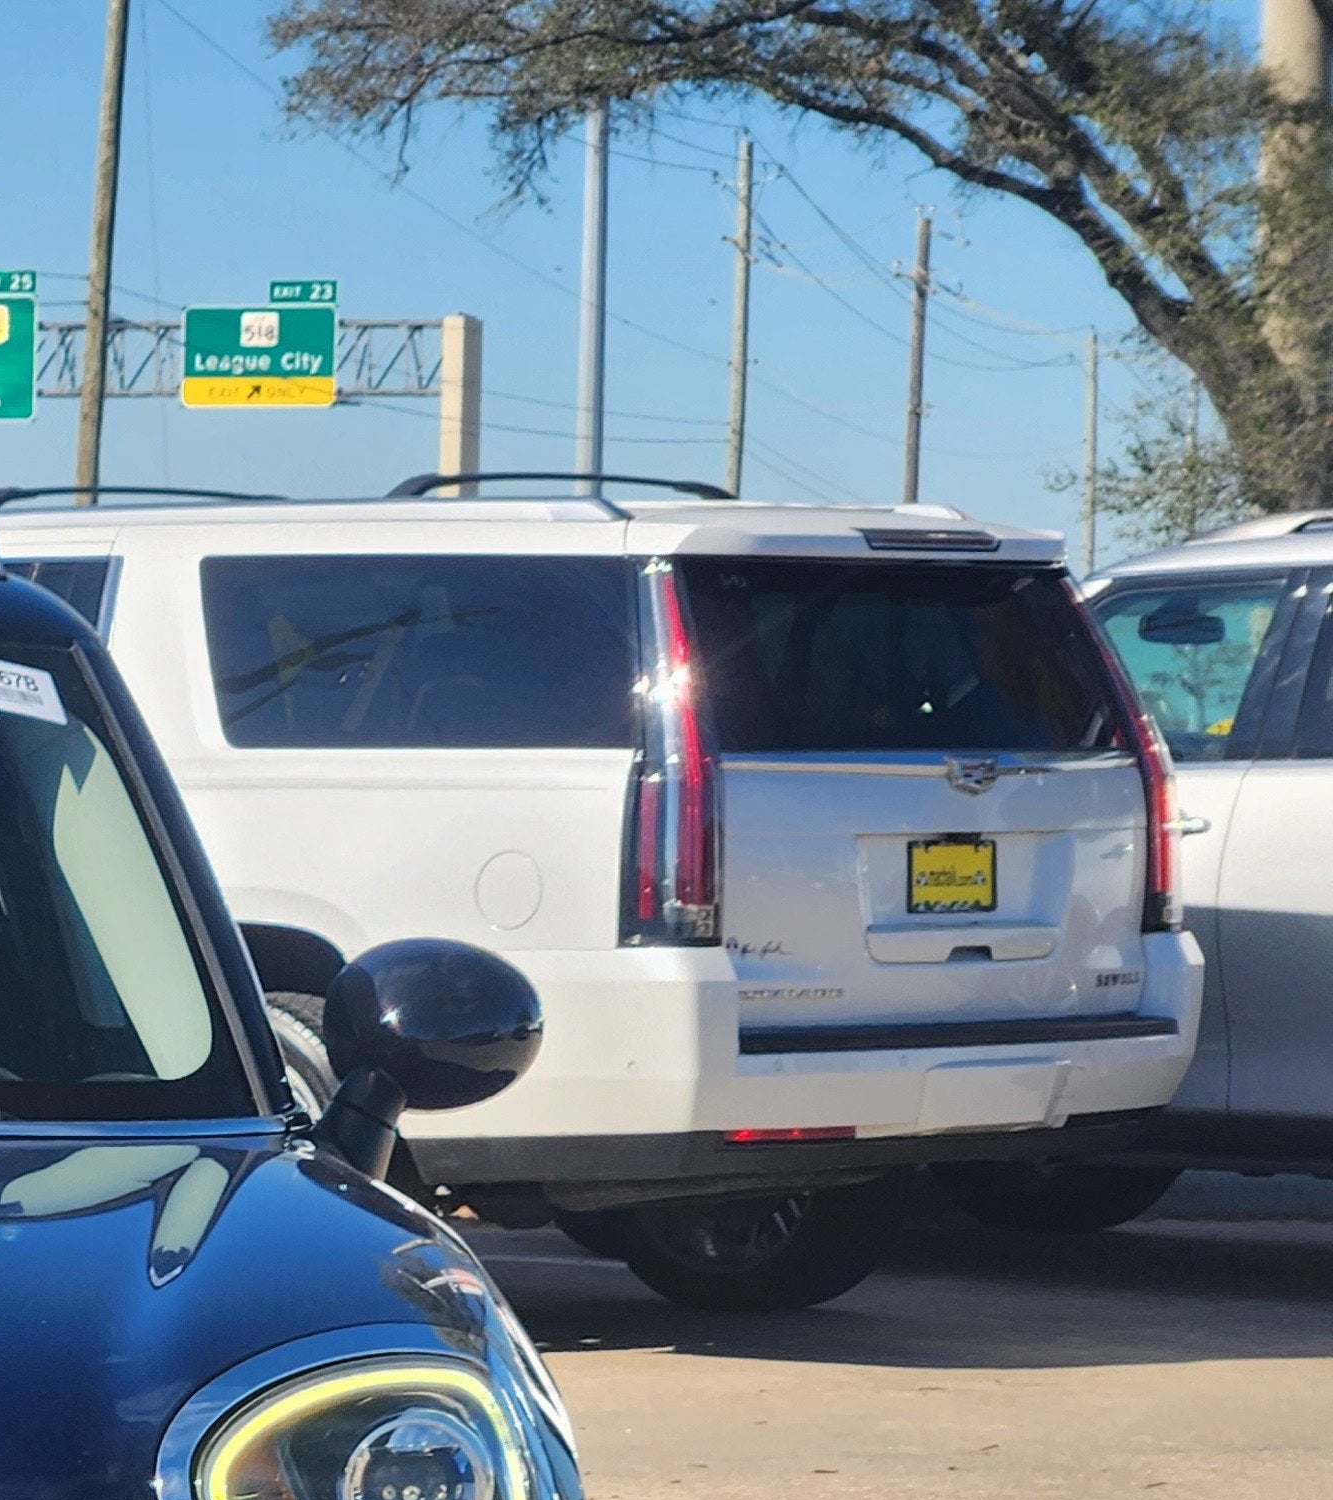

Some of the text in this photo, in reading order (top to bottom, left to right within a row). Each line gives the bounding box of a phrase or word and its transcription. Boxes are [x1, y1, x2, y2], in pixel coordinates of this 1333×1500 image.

[10, 272, 33, 291] 25
[273, 283, 333, 300] EXIT 23
[194, 351, 323, 375] League City
